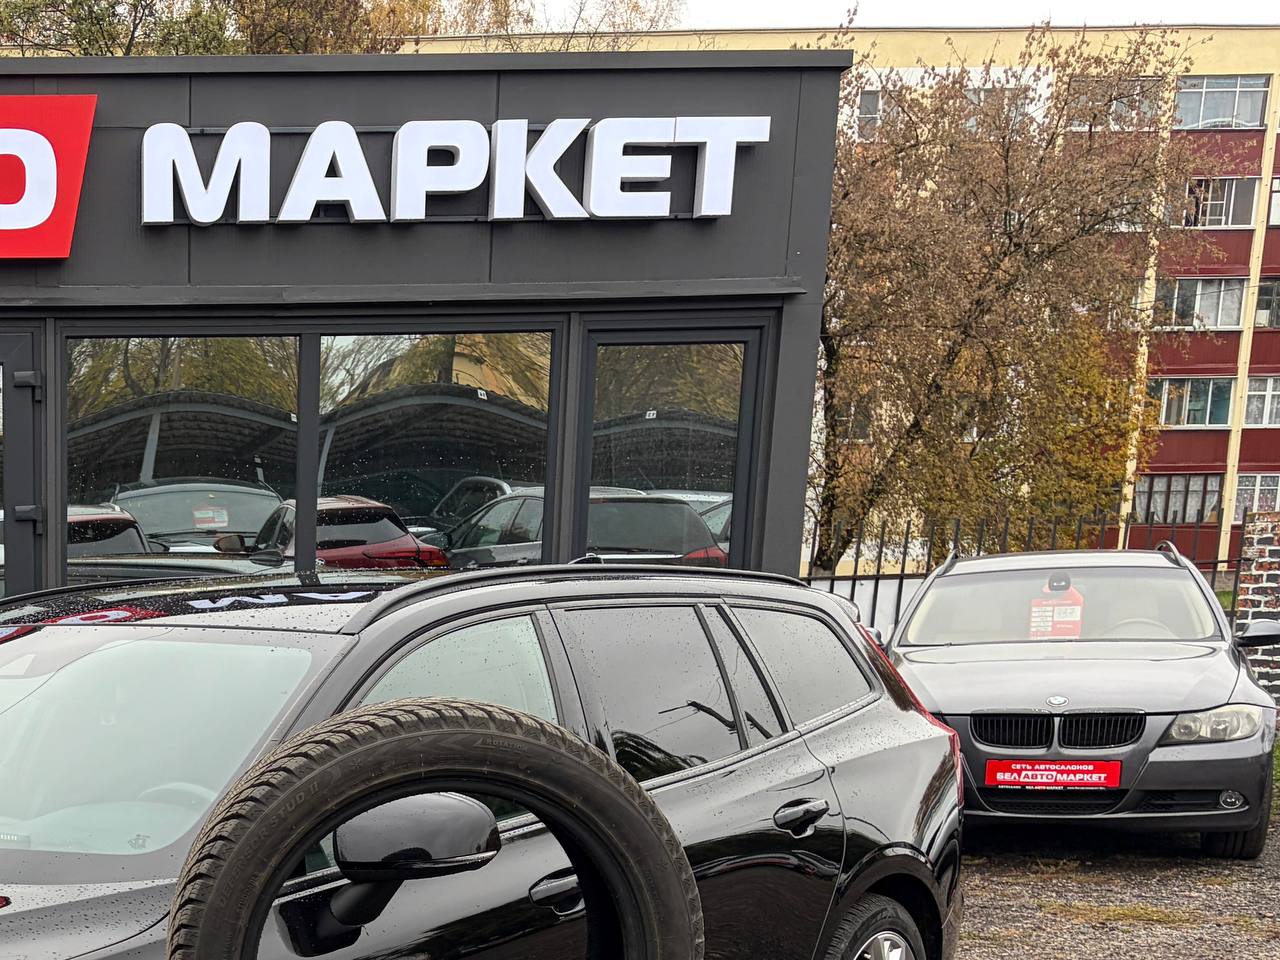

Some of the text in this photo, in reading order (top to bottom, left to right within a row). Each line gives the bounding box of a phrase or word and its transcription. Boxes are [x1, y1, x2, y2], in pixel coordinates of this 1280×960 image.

[140, 115, 772, 226] МАРКЕТ
[996, 772, 1107, 782] БЕЛ АВТО МАРКЕТ
[266, 789, 308, 828] STUD
